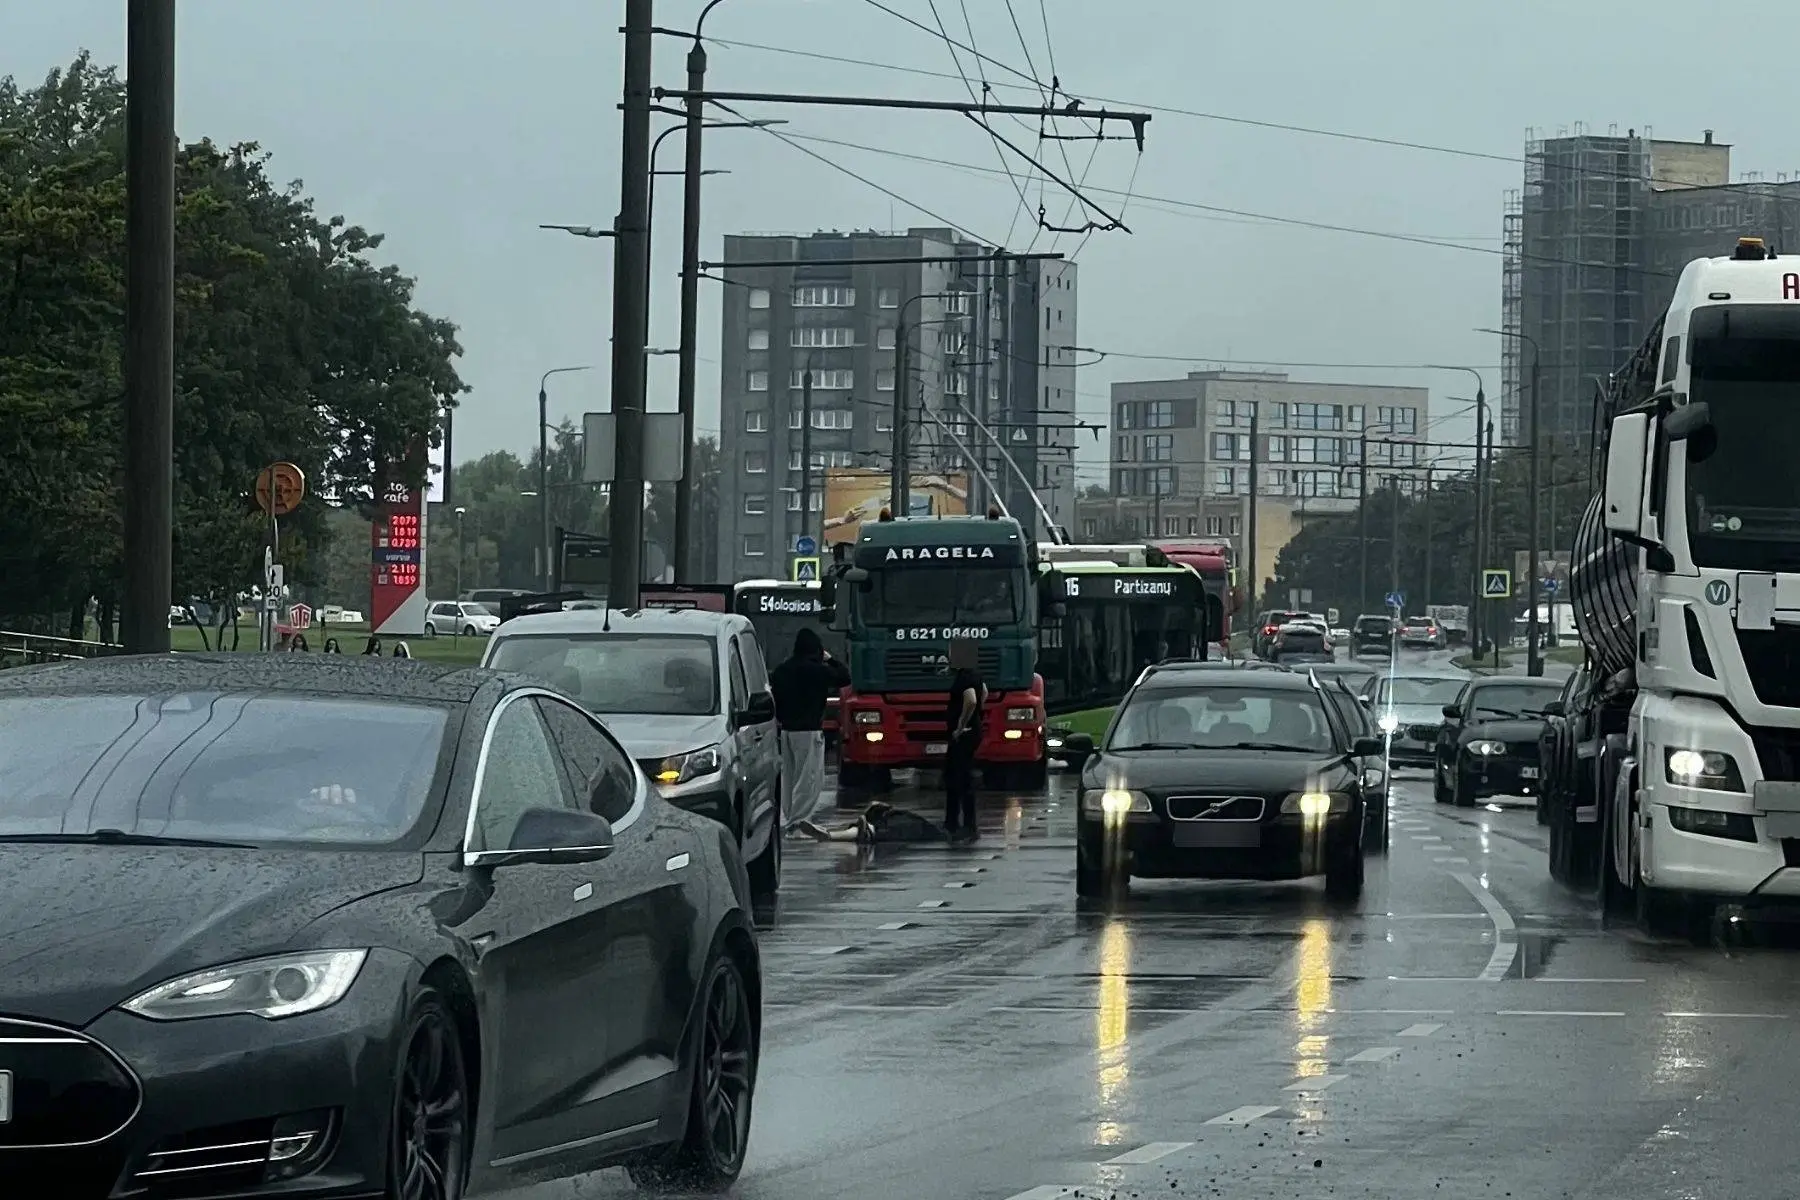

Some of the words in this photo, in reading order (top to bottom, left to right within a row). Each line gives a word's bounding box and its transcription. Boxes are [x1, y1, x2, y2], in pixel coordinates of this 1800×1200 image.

[886, 547, 994, 560] ARAGELA
[1065, 577, 1079, 596] 16
[895, 629, 905, 640] 8
[910, 628, 936, 639] 621
[942, 627, 989, 639] 08400
[921, 655, 949, 664] MA
